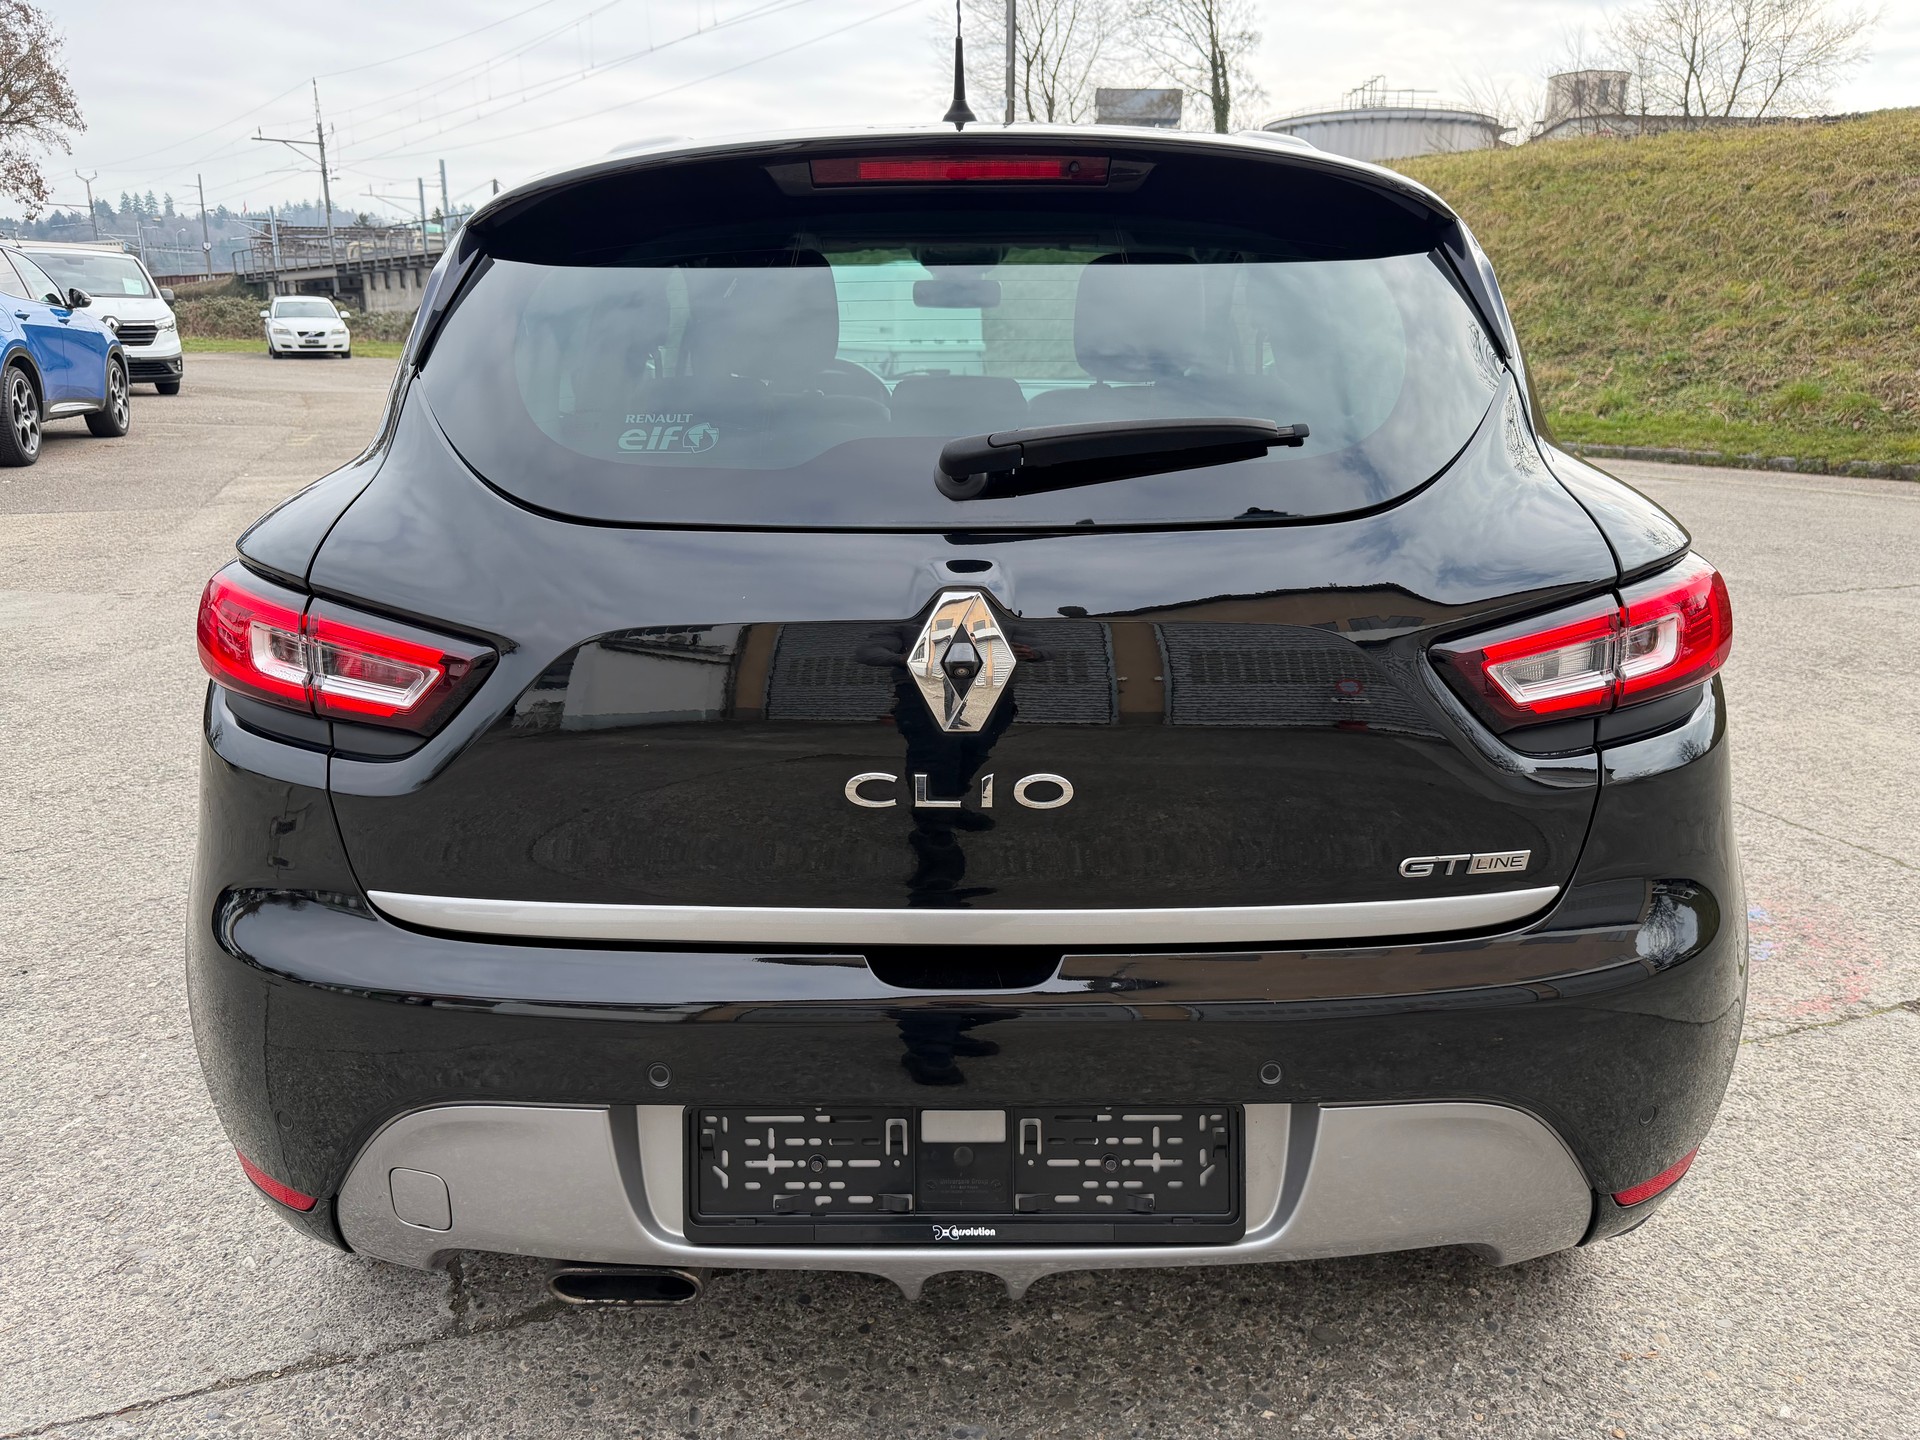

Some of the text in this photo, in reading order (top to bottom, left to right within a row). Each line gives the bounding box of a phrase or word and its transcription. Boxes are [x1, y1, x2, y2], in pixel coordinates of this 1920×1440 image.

[625, 413, 693, 423] RENAULT
[618, 426, 683, 450] elf
[844, 772, 1075, 810] CLIO
[1400, 853, 1525, 878] GT LINE
